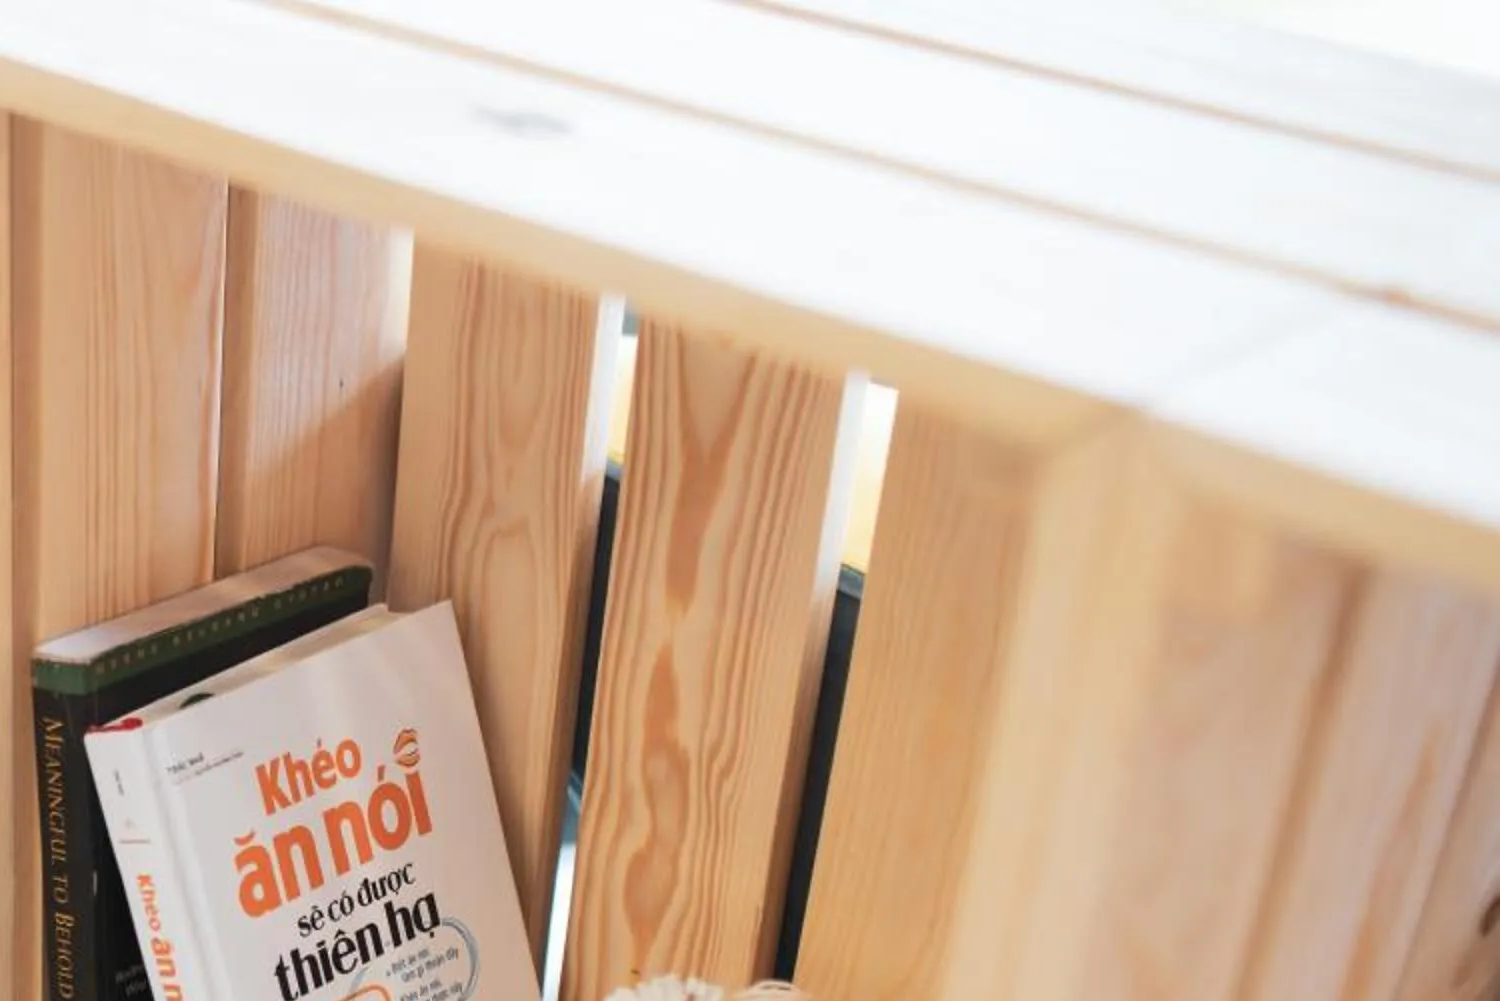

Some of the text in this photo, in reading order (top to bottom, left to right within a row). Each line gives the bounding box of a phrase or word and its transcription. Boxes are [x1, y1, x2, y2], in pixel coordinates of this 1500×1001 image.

[255, 738, 361, 816] Khéo
[42, 716, 75, 999] MEANINGFUL TO BEHOLD
[234, 765, 432, 918] ăn nói
[298, 863, 417, 938] sẽ có được
[384, 893, 441, 948] hạ
